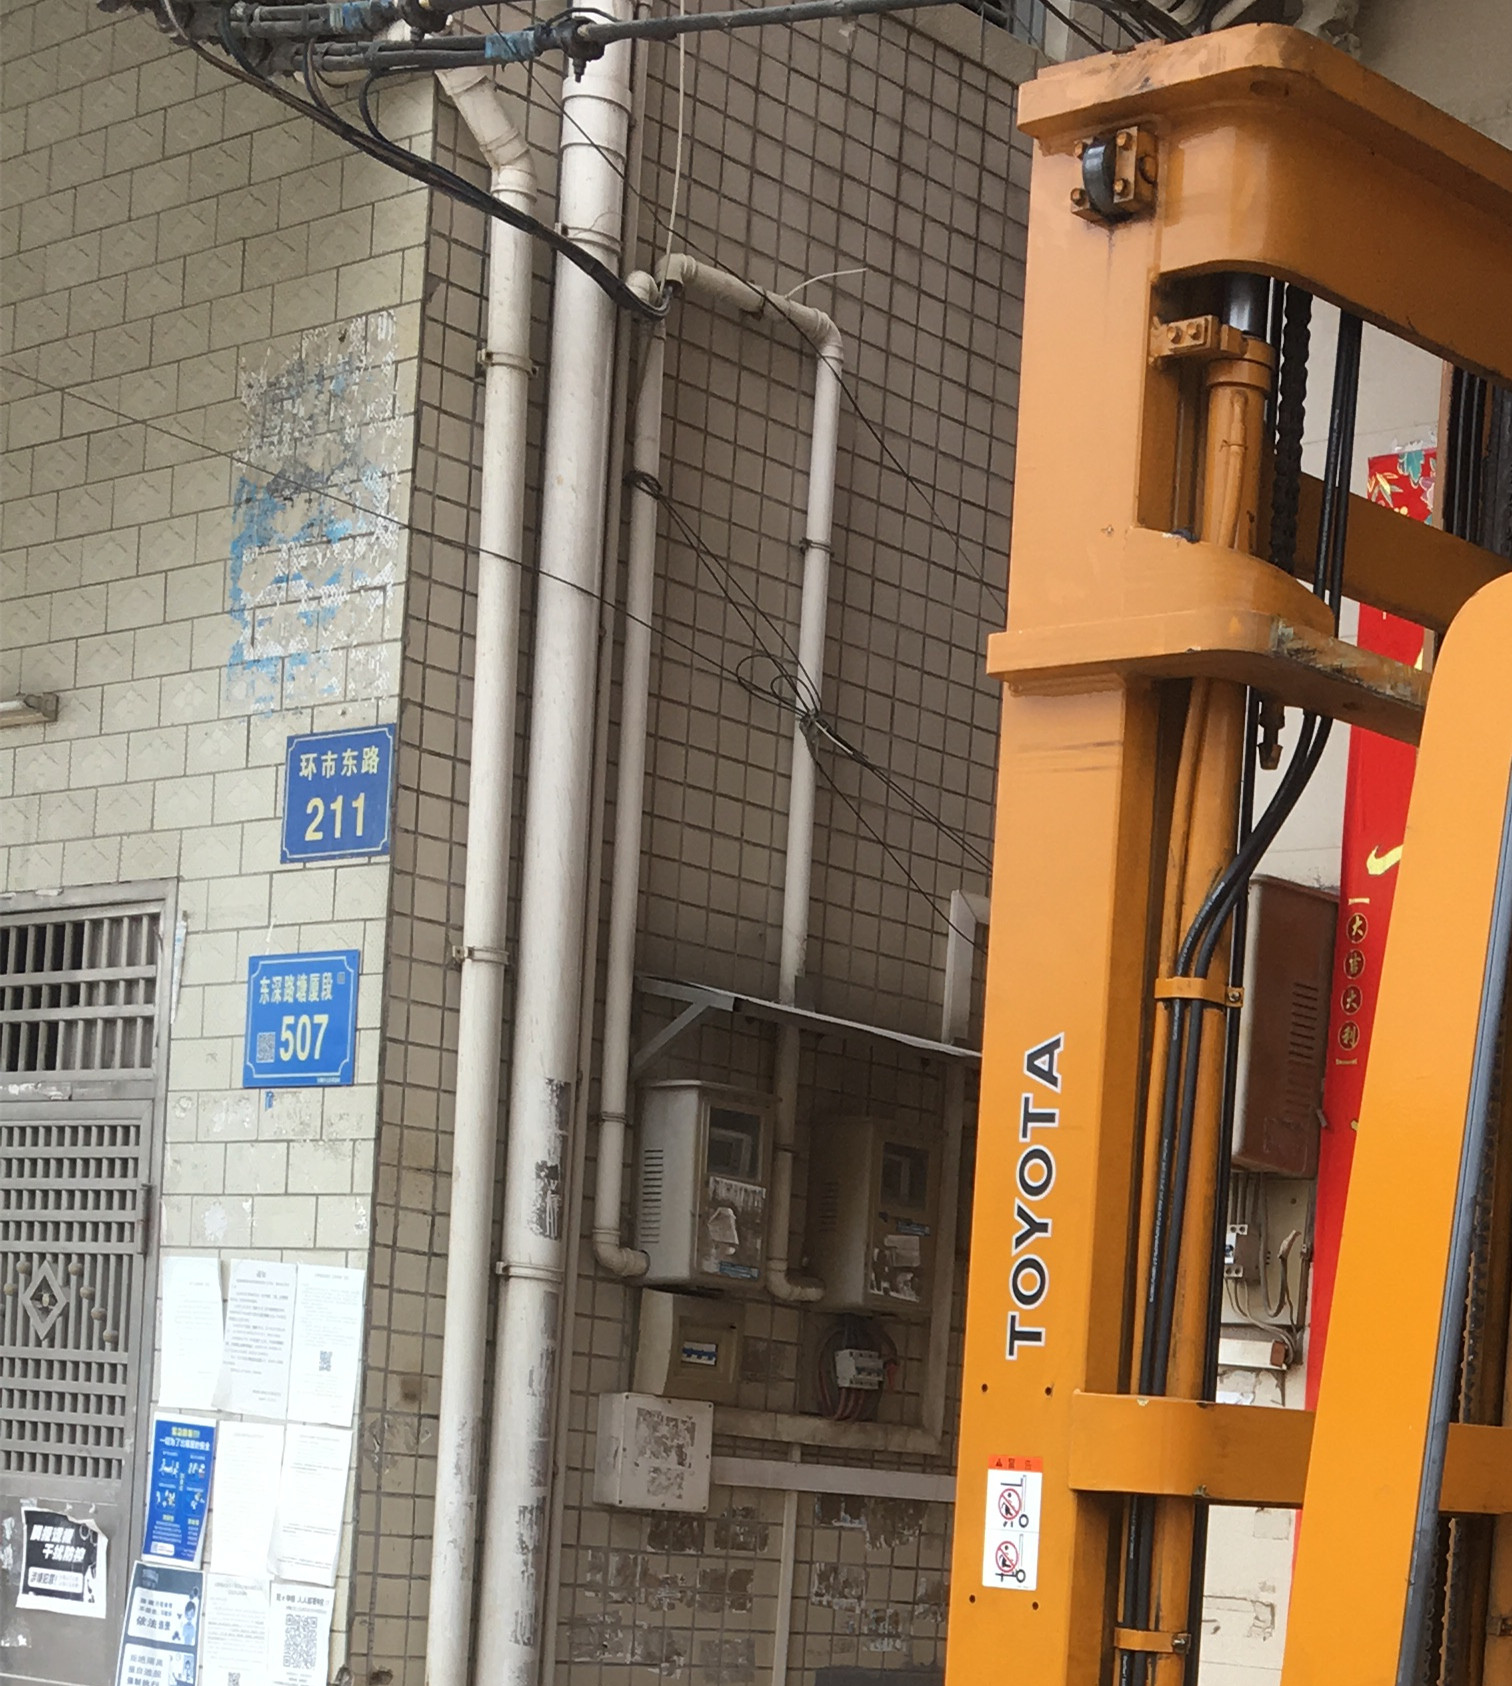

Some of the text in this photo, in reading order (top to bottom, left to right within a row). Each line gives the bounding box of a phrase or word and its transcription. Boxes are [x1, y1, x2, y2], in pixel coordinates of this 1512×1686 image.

[299, 745, 380, 779] 环市东路
[304, 793, 365, 842] 211
[259, 972, 333, 1005] 东深路塘厦段
[1339, 914, 1367, 1049] 大吉大利
[280, 1014, 329, 1061] 507
[1005, 1032, 1065, 1360] TOYOTA
